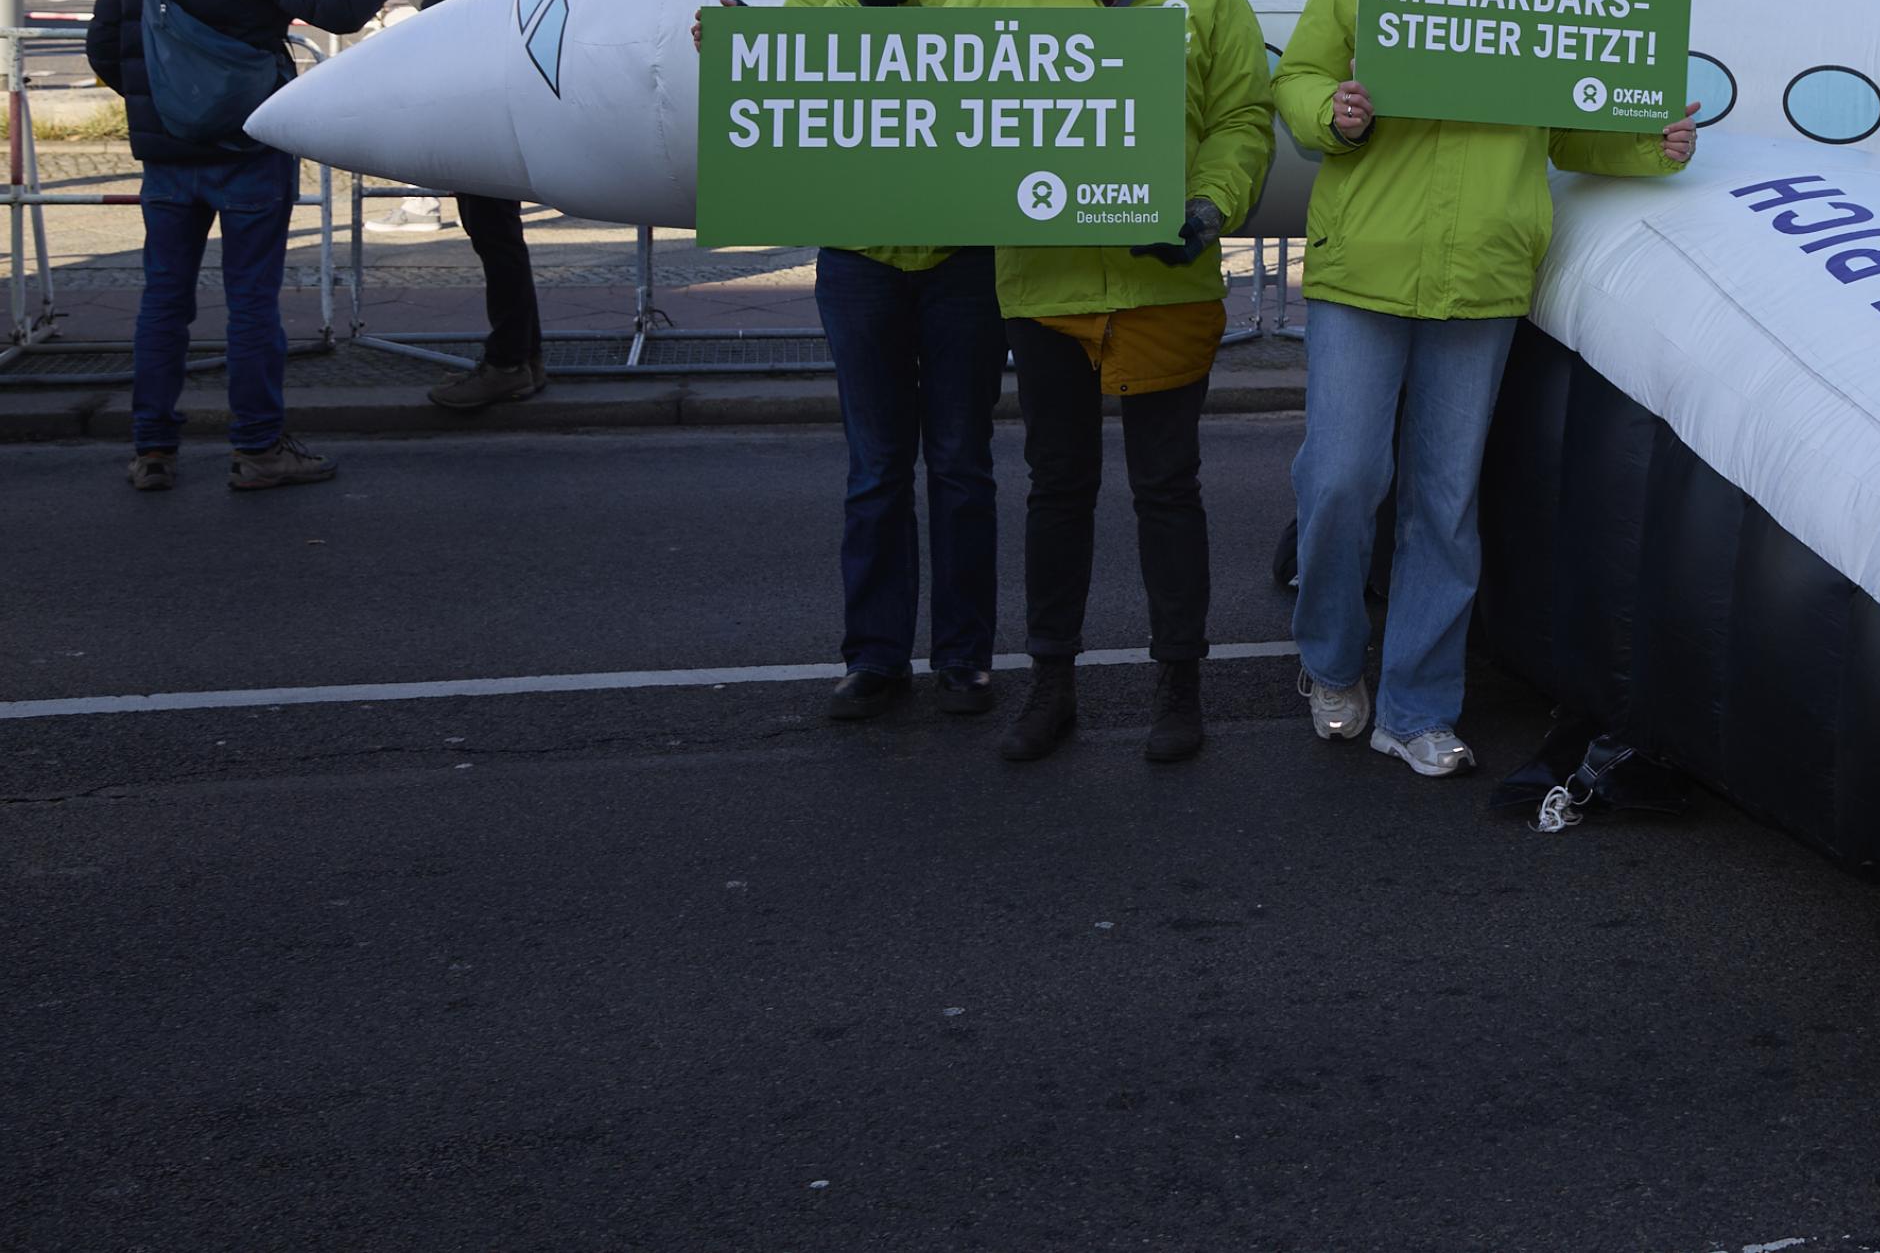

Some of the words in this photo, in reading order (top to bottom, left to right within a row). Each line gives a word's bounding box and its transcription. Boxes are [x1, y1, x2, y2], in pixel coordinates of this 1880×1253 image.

[1377, 12, 1521, 57] STEUER
[1533, 23, 1656, 66] JETZT!
[731, 20, 1125, 82] MILLIARDÄRS-
[1612, 88, 1664, 106] OXFAM
[728, 98, 938, 148] STEUER
[956, 98, 1136, 148] JETZT!
[1612, 106, 1669, 120] Deutschland
[1076, 183, 1149, 205] OXFAM
[1076, 210, 1159, 224] Deutschland
